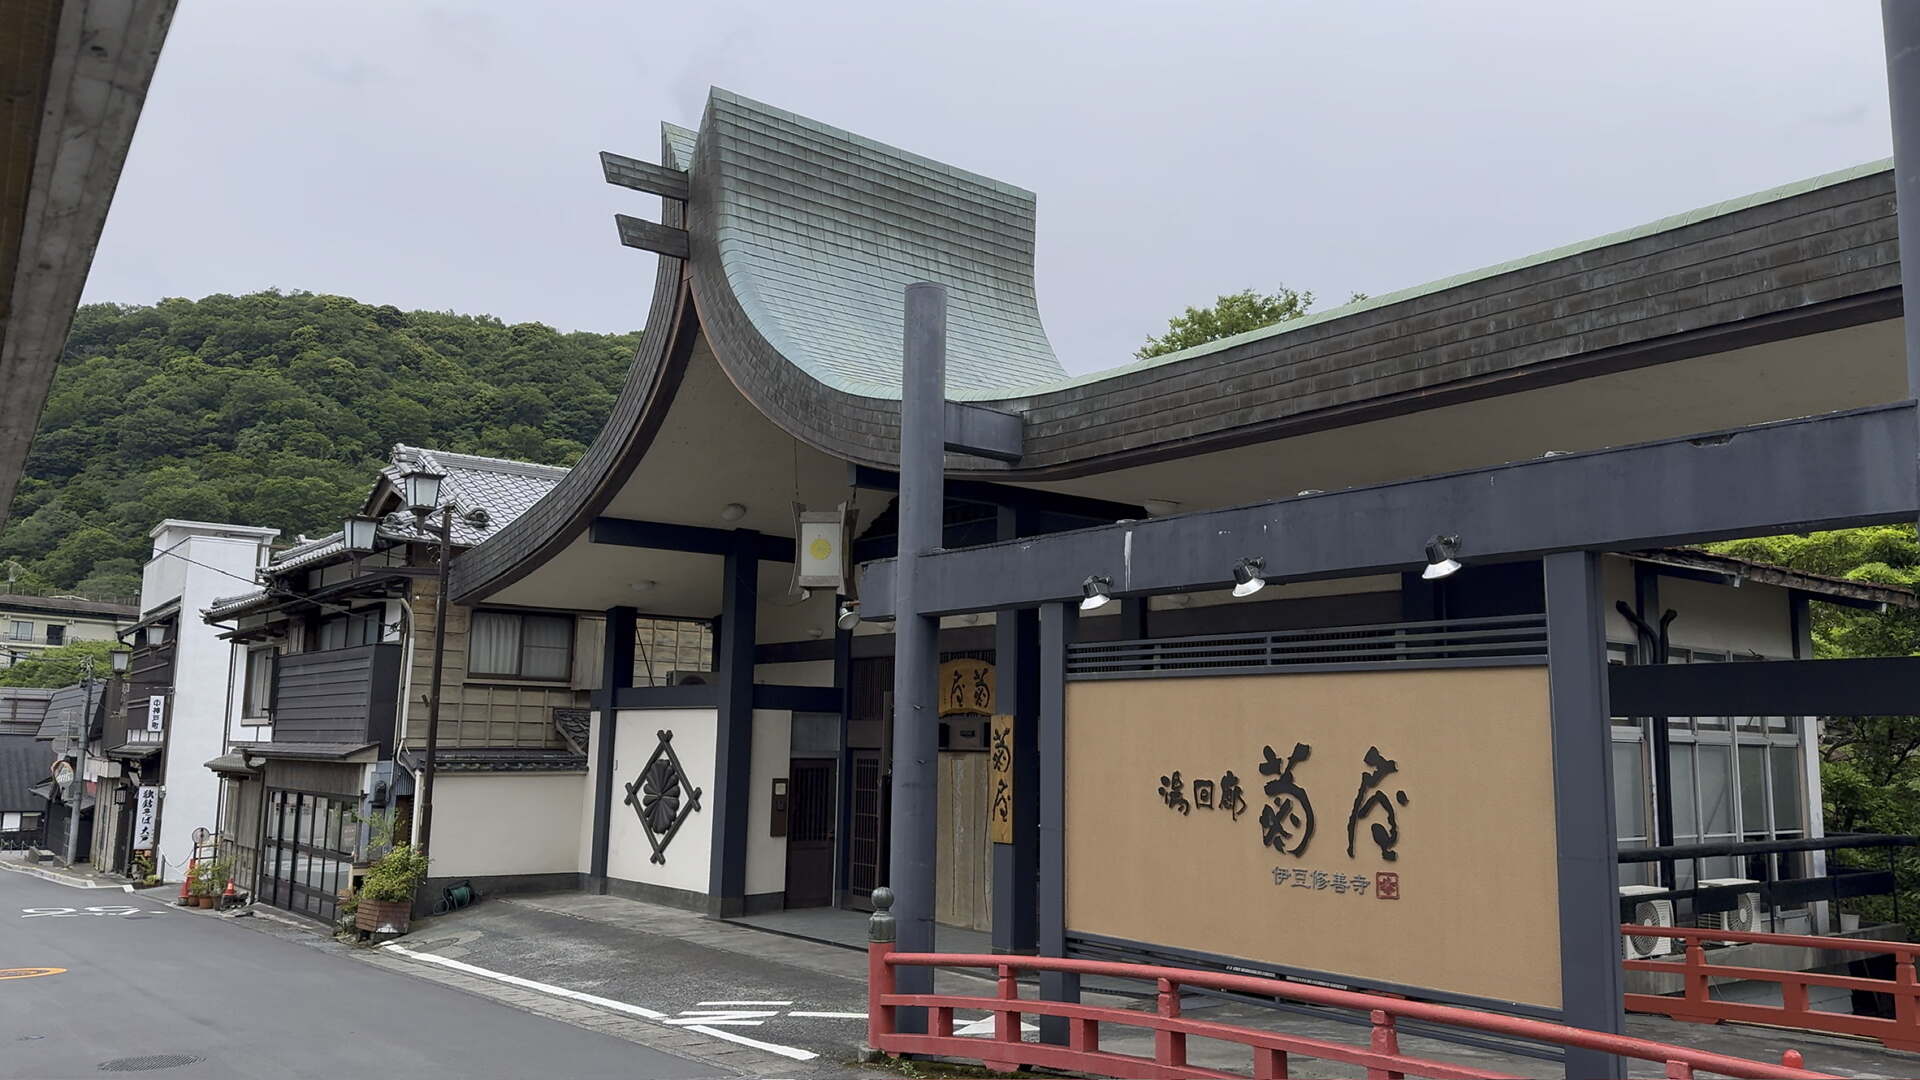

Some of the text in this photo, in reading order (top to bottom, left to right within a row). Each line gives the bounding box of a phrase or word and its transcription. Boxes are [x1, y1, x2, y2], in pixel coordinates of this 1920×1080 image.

[1272, 866, 1372, 896] 伊豆修善寺
